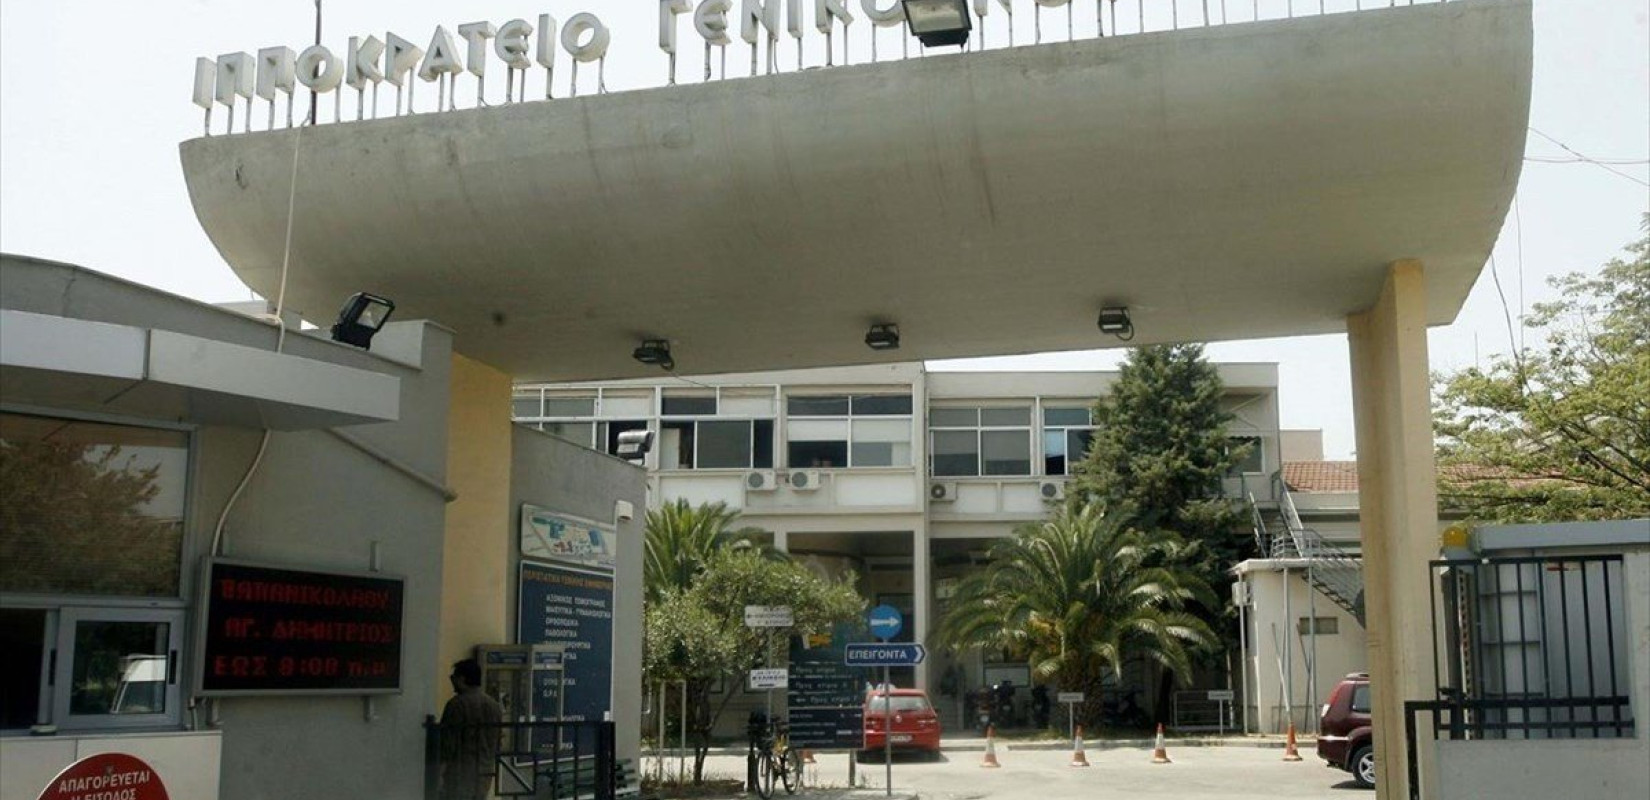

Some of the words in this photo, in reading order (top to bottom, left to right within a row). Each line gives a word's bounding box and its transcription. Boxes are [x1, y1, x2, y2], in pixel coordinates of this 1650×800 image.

[192, 12, 610, 109] ΙΠΠΟΚΡΑΤΕΙΟ
[849, 649, 907, 660] ΕΠΕΙΓΟΝΤΑ
[214, 656, 267, 676] ΕΩΣ
[59, 771, 150, 794] ΑΠΑΓΟΡΕΥΕΤΑΙ
